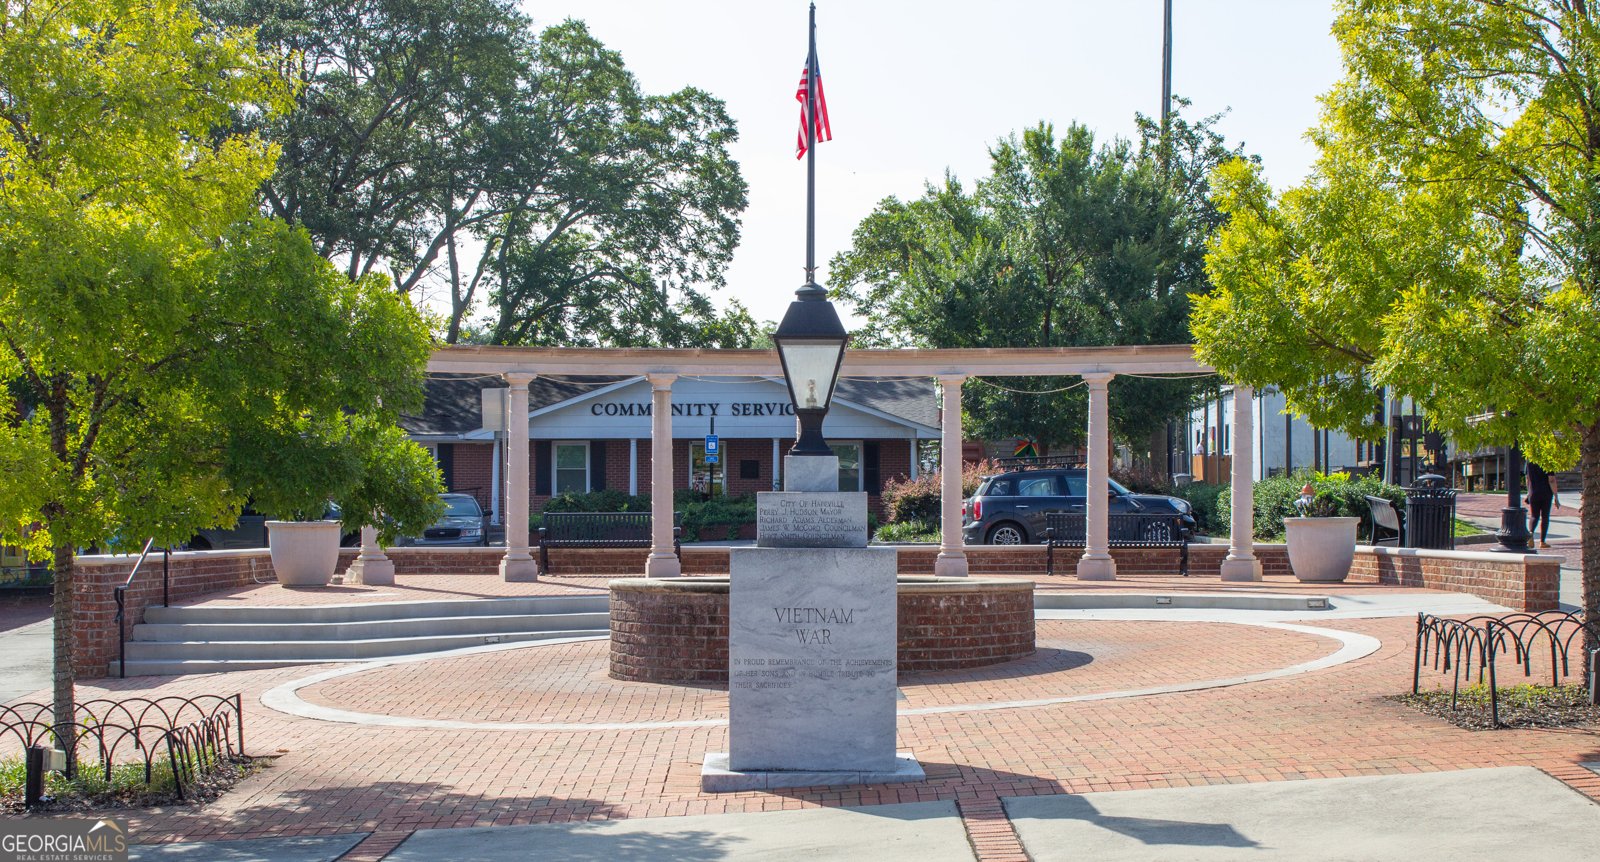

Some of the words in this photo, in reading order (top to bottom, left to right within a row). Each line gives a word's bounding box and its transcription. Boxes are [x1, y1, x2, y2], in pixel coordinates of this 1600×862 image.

[591, 402, 720, 417] COMMNITY
[731, 402, 796, 417] SERVIC
[780, 500, 796, 508] CITY
[759, 508, 779, 516] PERRY
[820, 508, 842, 516] MAYOR
[759, 516, 788, 524] RICHARD
[759, 524, 780, 532] JAMES
[824, 524, 866, 532] COUNCILMAN
[774, 607, 855, 624] VIETNAM
[795, 628, 832, 645] WAR
[743, 658, 766, 666] PROUD
[768, 658, 815, 666] REMEMBRANCE
[830, 658, 842, 666] THE
[845, 658, 893, 666] ACHIEVEMENTS
[746, 670, 758, 678] HER
[761, 670, 779, 678] SONS
[735, 681, 753, 689] THEIR
